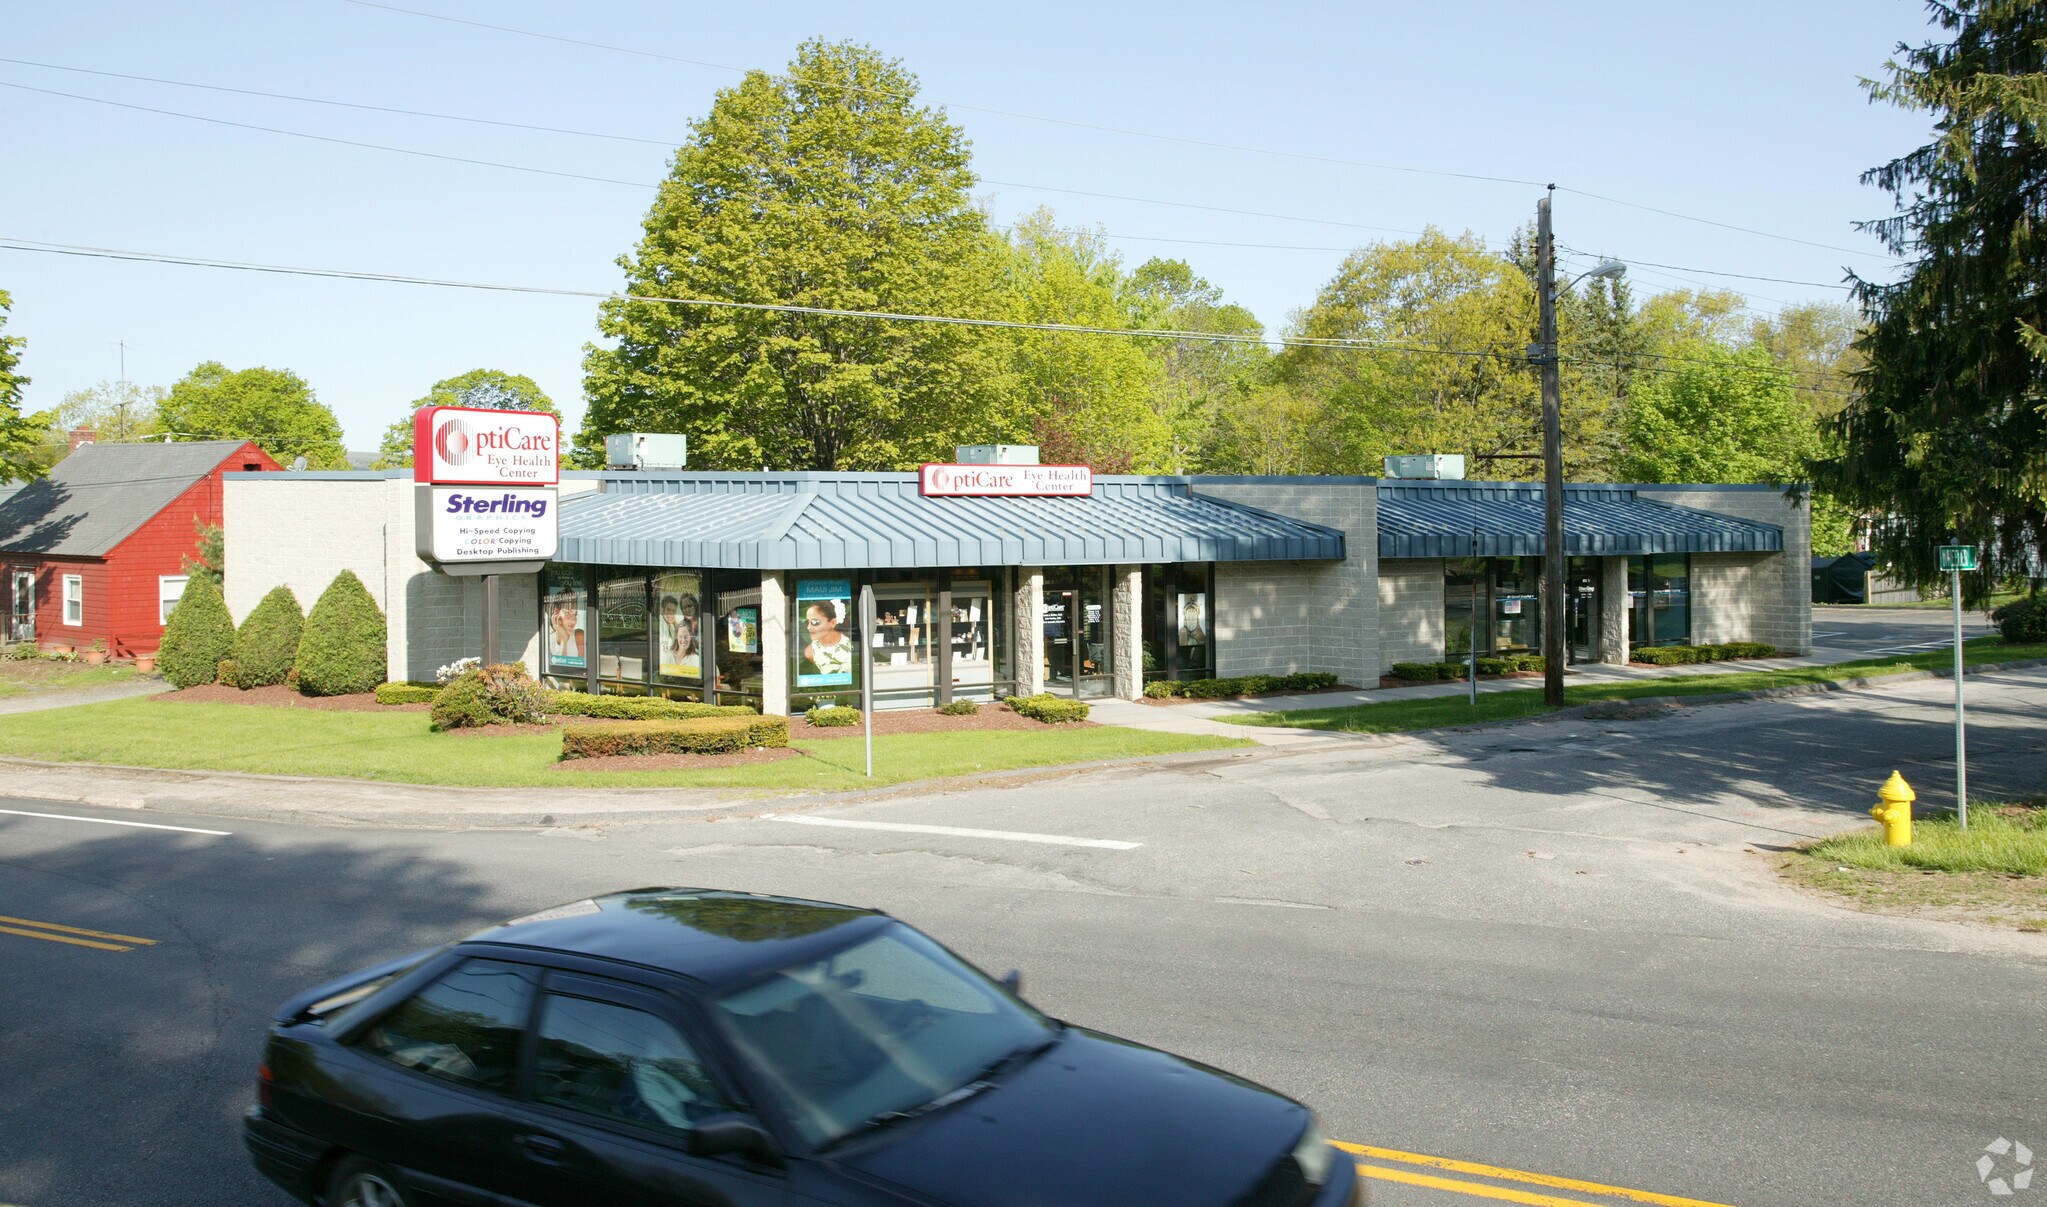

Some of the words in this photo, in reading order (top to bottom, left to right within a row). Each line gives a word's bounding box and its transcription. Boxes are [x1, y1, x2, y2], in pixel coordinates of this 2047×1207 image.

[487, 454, 507, 468] Eye
[513, 455, 551, 467] Health
[499, 467, 538, 478] Center
[1024, 470, 1044, 483] Eye
[1048, 470, 1087, 481] Health
[1035, 480, 1074, 491] Center
[446, 493, 547, 518] Sterling
[459, 527, 500, 535] Hi-Speed
[503, 527, 536, 535] Copying
[498, 537, 532, 545] Copying
[456, 548, 494, 556] Desktop
[497, 547, 539, 555] Publishing
